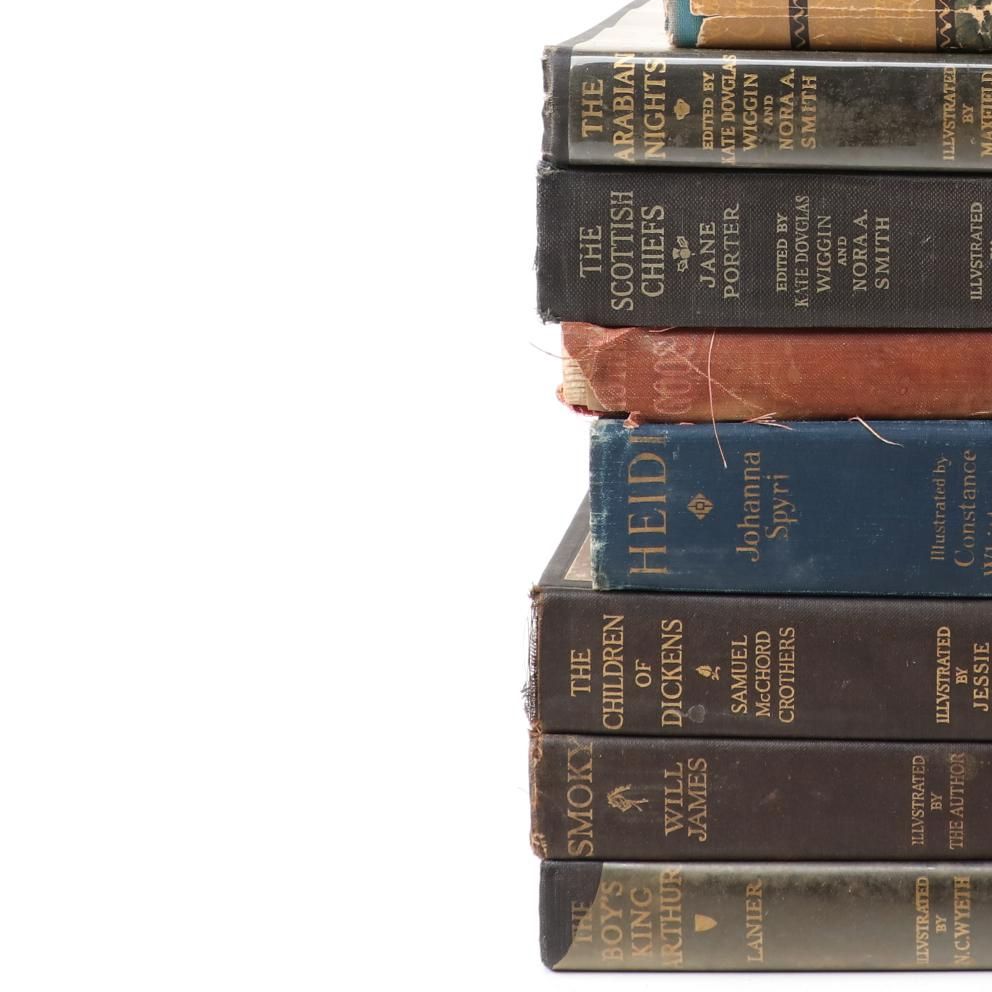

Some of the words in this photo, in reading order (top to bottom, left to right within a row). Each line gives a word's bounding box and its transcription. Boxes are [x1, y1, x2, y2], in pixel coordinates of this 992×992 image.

[581, 79, 604, 138] THE
[613, 53, 635, 162] ARABIAN
[644, 58, 666, 159] NIGHTS
[703, 72, 715, 92] BY
[721, 54, 737, 122] DOVGLAS
[743, 73, 759, 152] WIGGIN
[763, 95, 773, 126] AND
[780, 68, 795, 87] A.
[802, 75, 817, 150] SMITH
[943, 66, 955, 160] ILLVSTRATED
[703, 97, 714, 150] EDITED
[721, 128, 736, 166] KATE
[780, 93, 794, 151] NORA
[962, 103, 974, 124] BY
[580, 224, 602, 278] THE
[611, 191, 634, 311] SCOTTISH
[641, 205, 665, 297] CHIEFS
[723, 204, 740, 299] PORTER
[777, 213, 788, 234] BY
[795, 195, 809, 262] DOVGLAS
[817, 214, 832, 293] WIGGIN
[838, 236, 847, 266] AND
[853, 209, 868, 227] A.
[875, 216, 890, 289] SMITH
[970, 202, 982, 300] ILLVSTRATED
[700, 221, 716, 288] JANE
[777, 238, 788, 292] EDITED
[795, 266, 809, 308] KATE
[853, 233, 868, 291] NORA
[933, 454, 951, 473] by
[628, 435, 668, 575] HEIDI
[736, 451, 761, 562] Johanna
[765, 474, 800, 541] Spyri
[930, 478, 946, 560] Illustrated
[954, 449, 977, 567] Constance
[571, 648, 591, 697] THE
[603, 614, 624, 730] CHILDREN
[635, 659, 651, 688] OF
[661, 618, 682, 727] DICKENS
[731, 635, 747, 714] SAMUEL
[755, 630, 771, 717] McCHORD
[779, 626, 795, 723] CROTHERS
[936, 626, 951, 723] ILLVSTRATED
[956, 666, 968, 684] BY
[973, 641, 990, 712] JESSIE
[567, 735, 594, 857] SMOKY
[665, 762, 683, 837] WILL
[688, 758, 707, 842] JAMES
[912, 755, 926, 846] ILLVSTRATED
[931, 792, 942, 811] BY
[950, 752, 966, 816] AUTHOR
[950, 819, 963, 850] THE
[571, 900, 593, 944] THE
[601, 880, 624, 961] BOY'S
[630, 887, 653, 956] KING
[660, 866, 683, 968] ARTHUR
[746, 879, 763, 962] LANIER
[916, 876, 929, 964] ILLVSTRATED
[936, 914, 947, 933] BY
